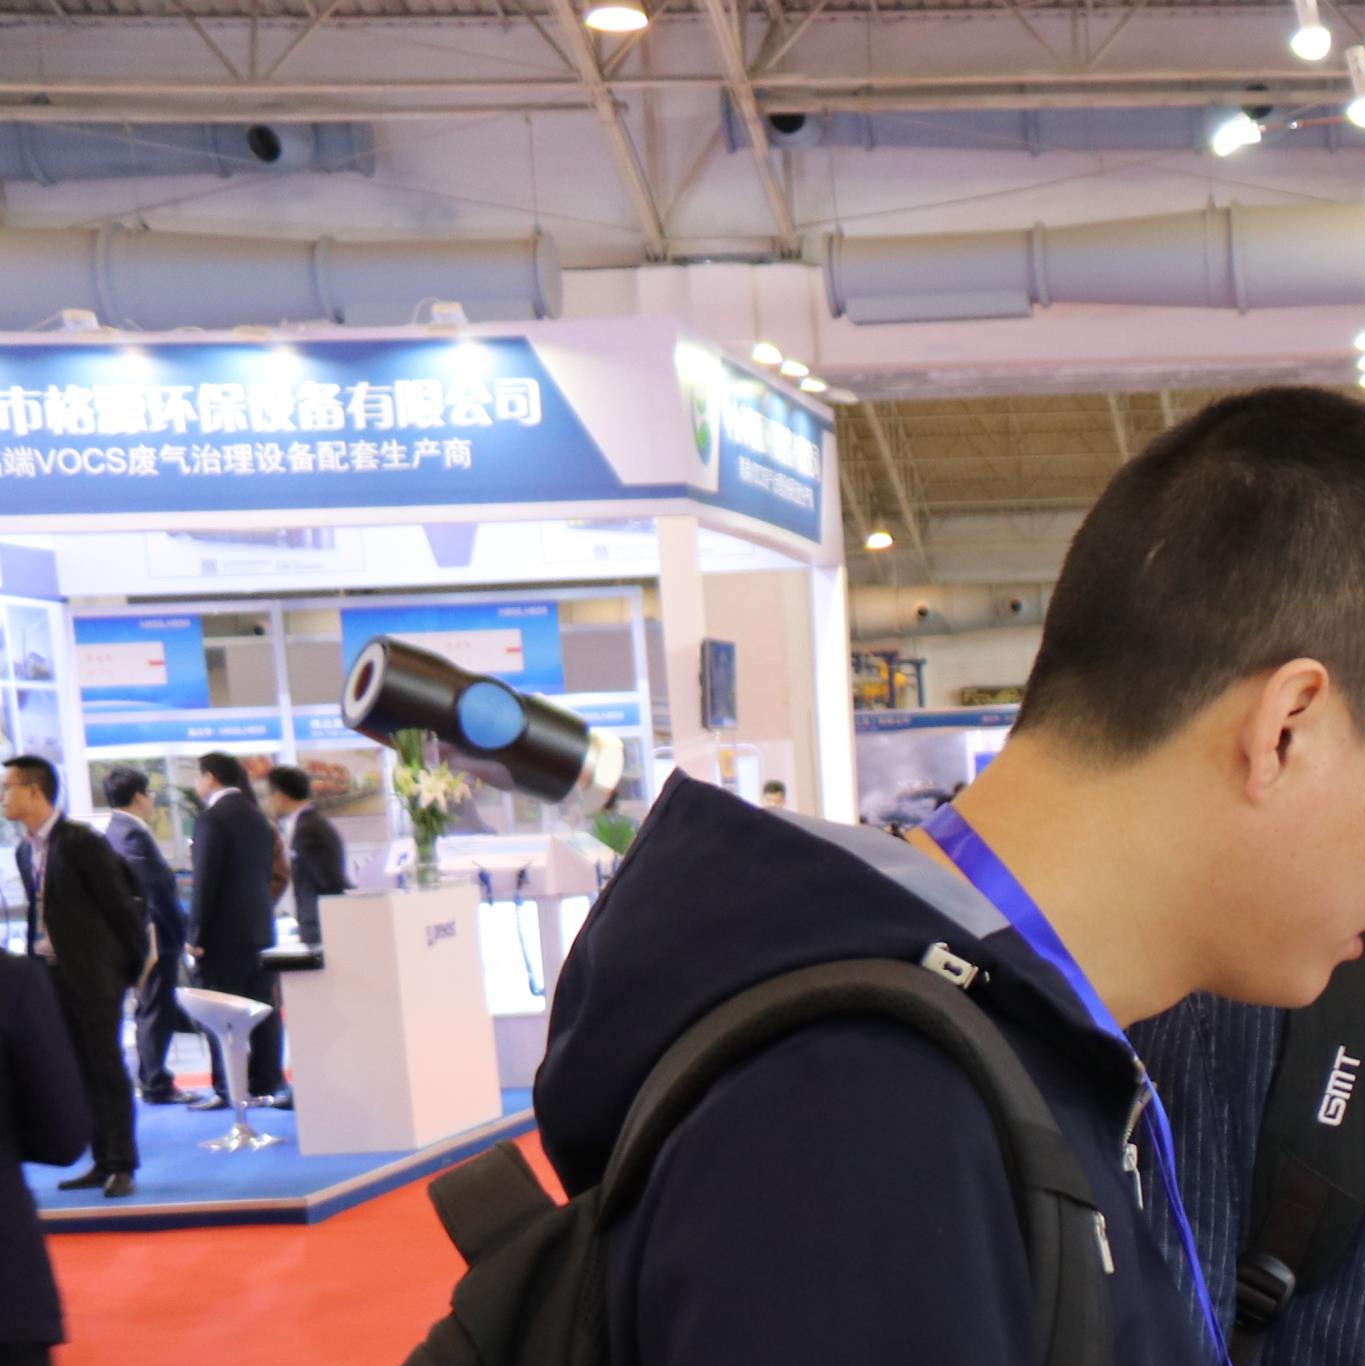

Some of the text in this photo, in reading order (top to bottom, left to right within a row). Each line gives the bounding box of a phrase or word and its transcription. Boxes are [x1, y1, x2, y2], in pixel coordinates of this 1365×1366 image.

[0, 438, 473, 477] 端VOCS废气治理设备配套生产商
[1317, 1045, 1361, 1127] GMT
